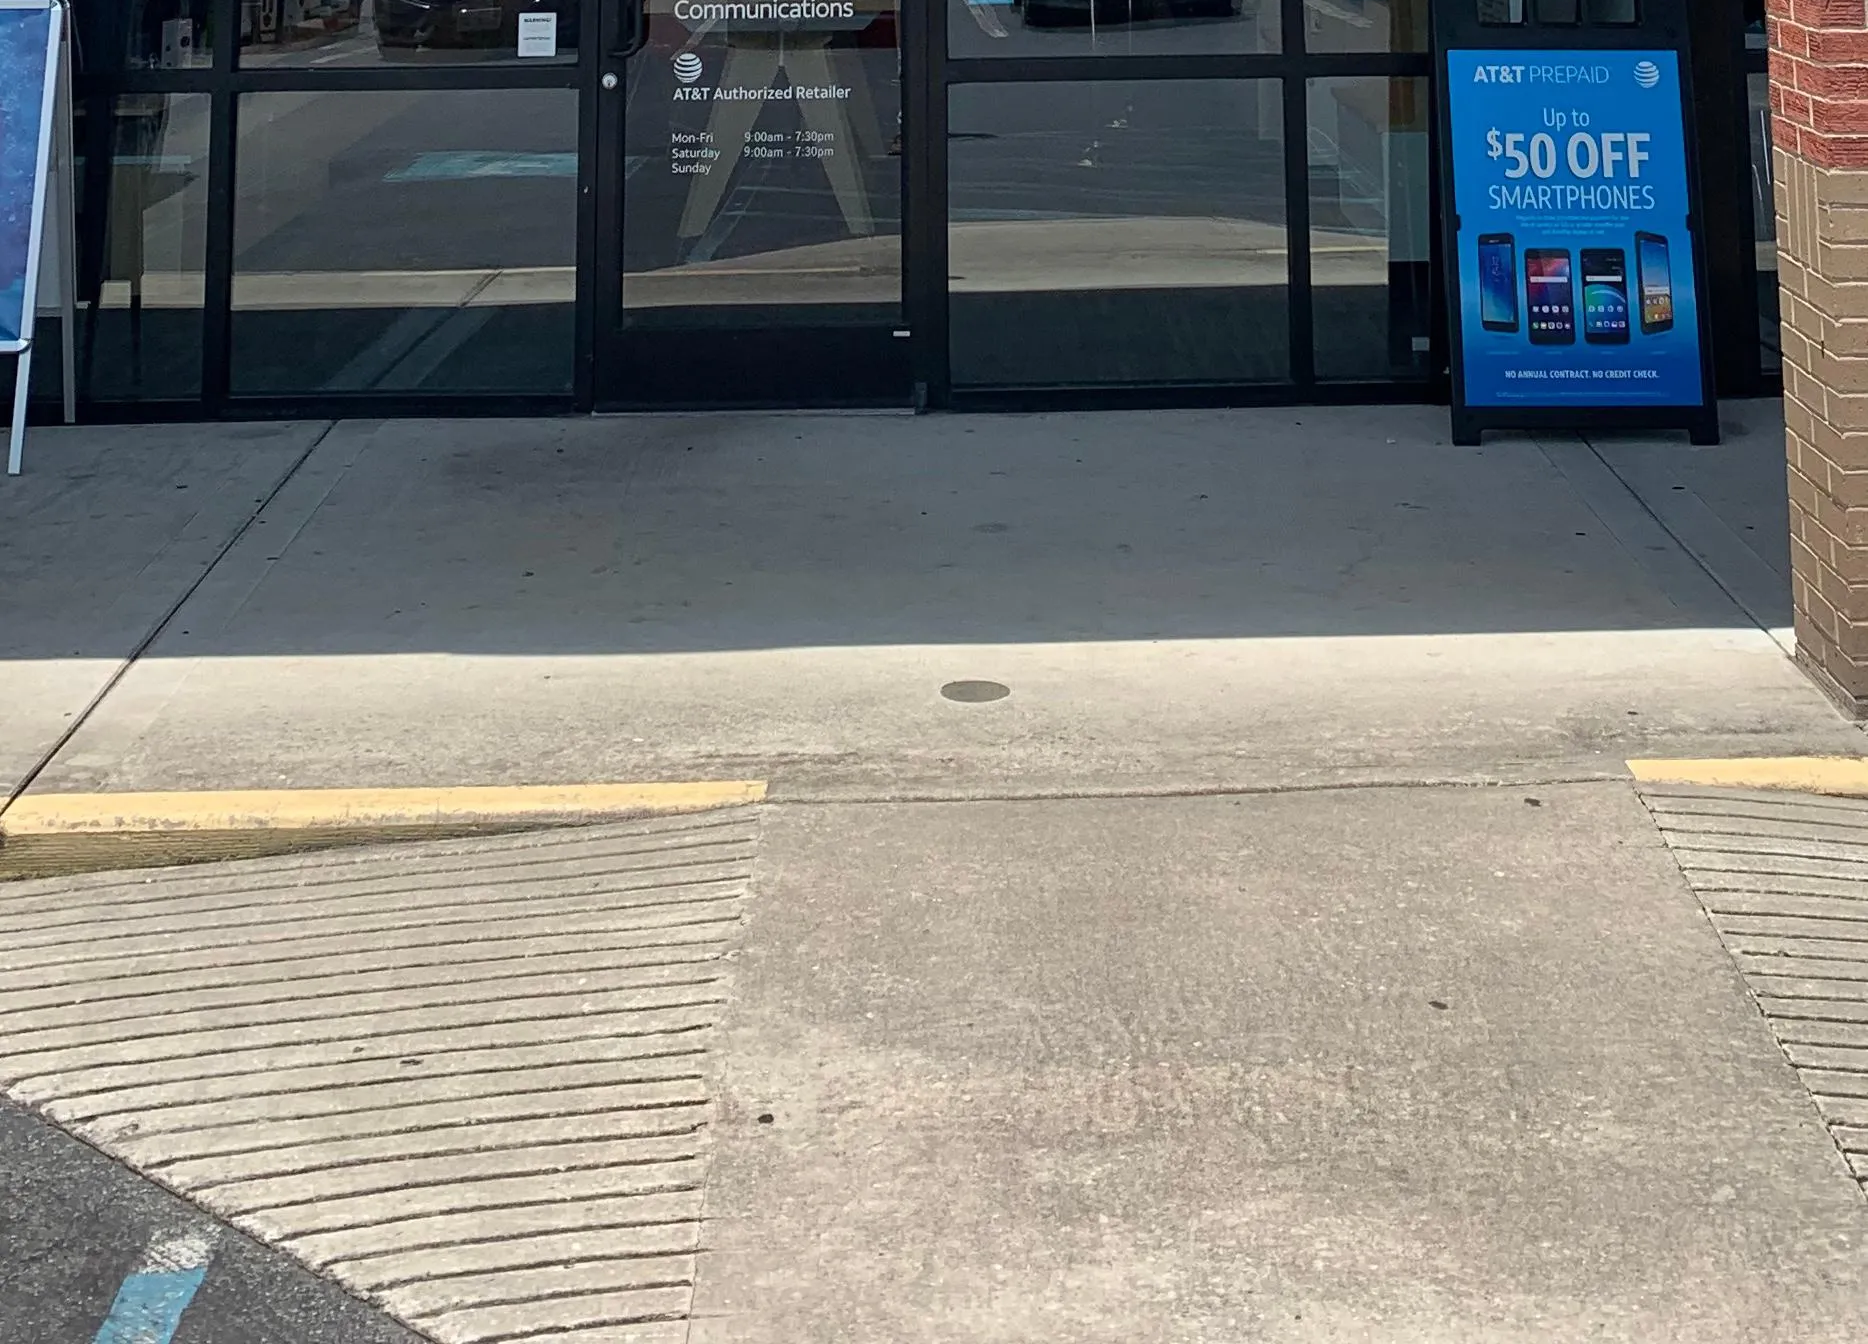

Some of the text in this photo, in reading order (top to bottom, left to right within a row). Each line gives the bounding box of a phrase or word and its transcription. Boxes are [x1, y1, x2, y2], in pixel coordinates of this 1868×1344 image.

[1473, 65, 1610, 84] AT&T PREPAID
[673, 85, 851, 100] AT&T Authorized Retailer
[1543, 108, 1590, 132] Up to
[671, 132, 714, 143] Mon-Fri
[744, 131, 784, 142] 9:00am
[795, 131, 834, 145] 7:30pm
[671, 148, 721, 160] Saturday
[743, 146, 783, 158] 9:00am
[795, 146, 834, 160] 7:30pm
[1486, 127, 1651, 179] $50 OFF
[671, 163, 712, 175] Sunday
[1488, 185, 1655, 210] SMARTPHONES
[1505, 370, 1516, 378] NO
[1518, 370, 1548, 378] ANNUAL
[1592, 370, 1603, 378] NO
[1605, 370, 1631, 378] CREDIT
